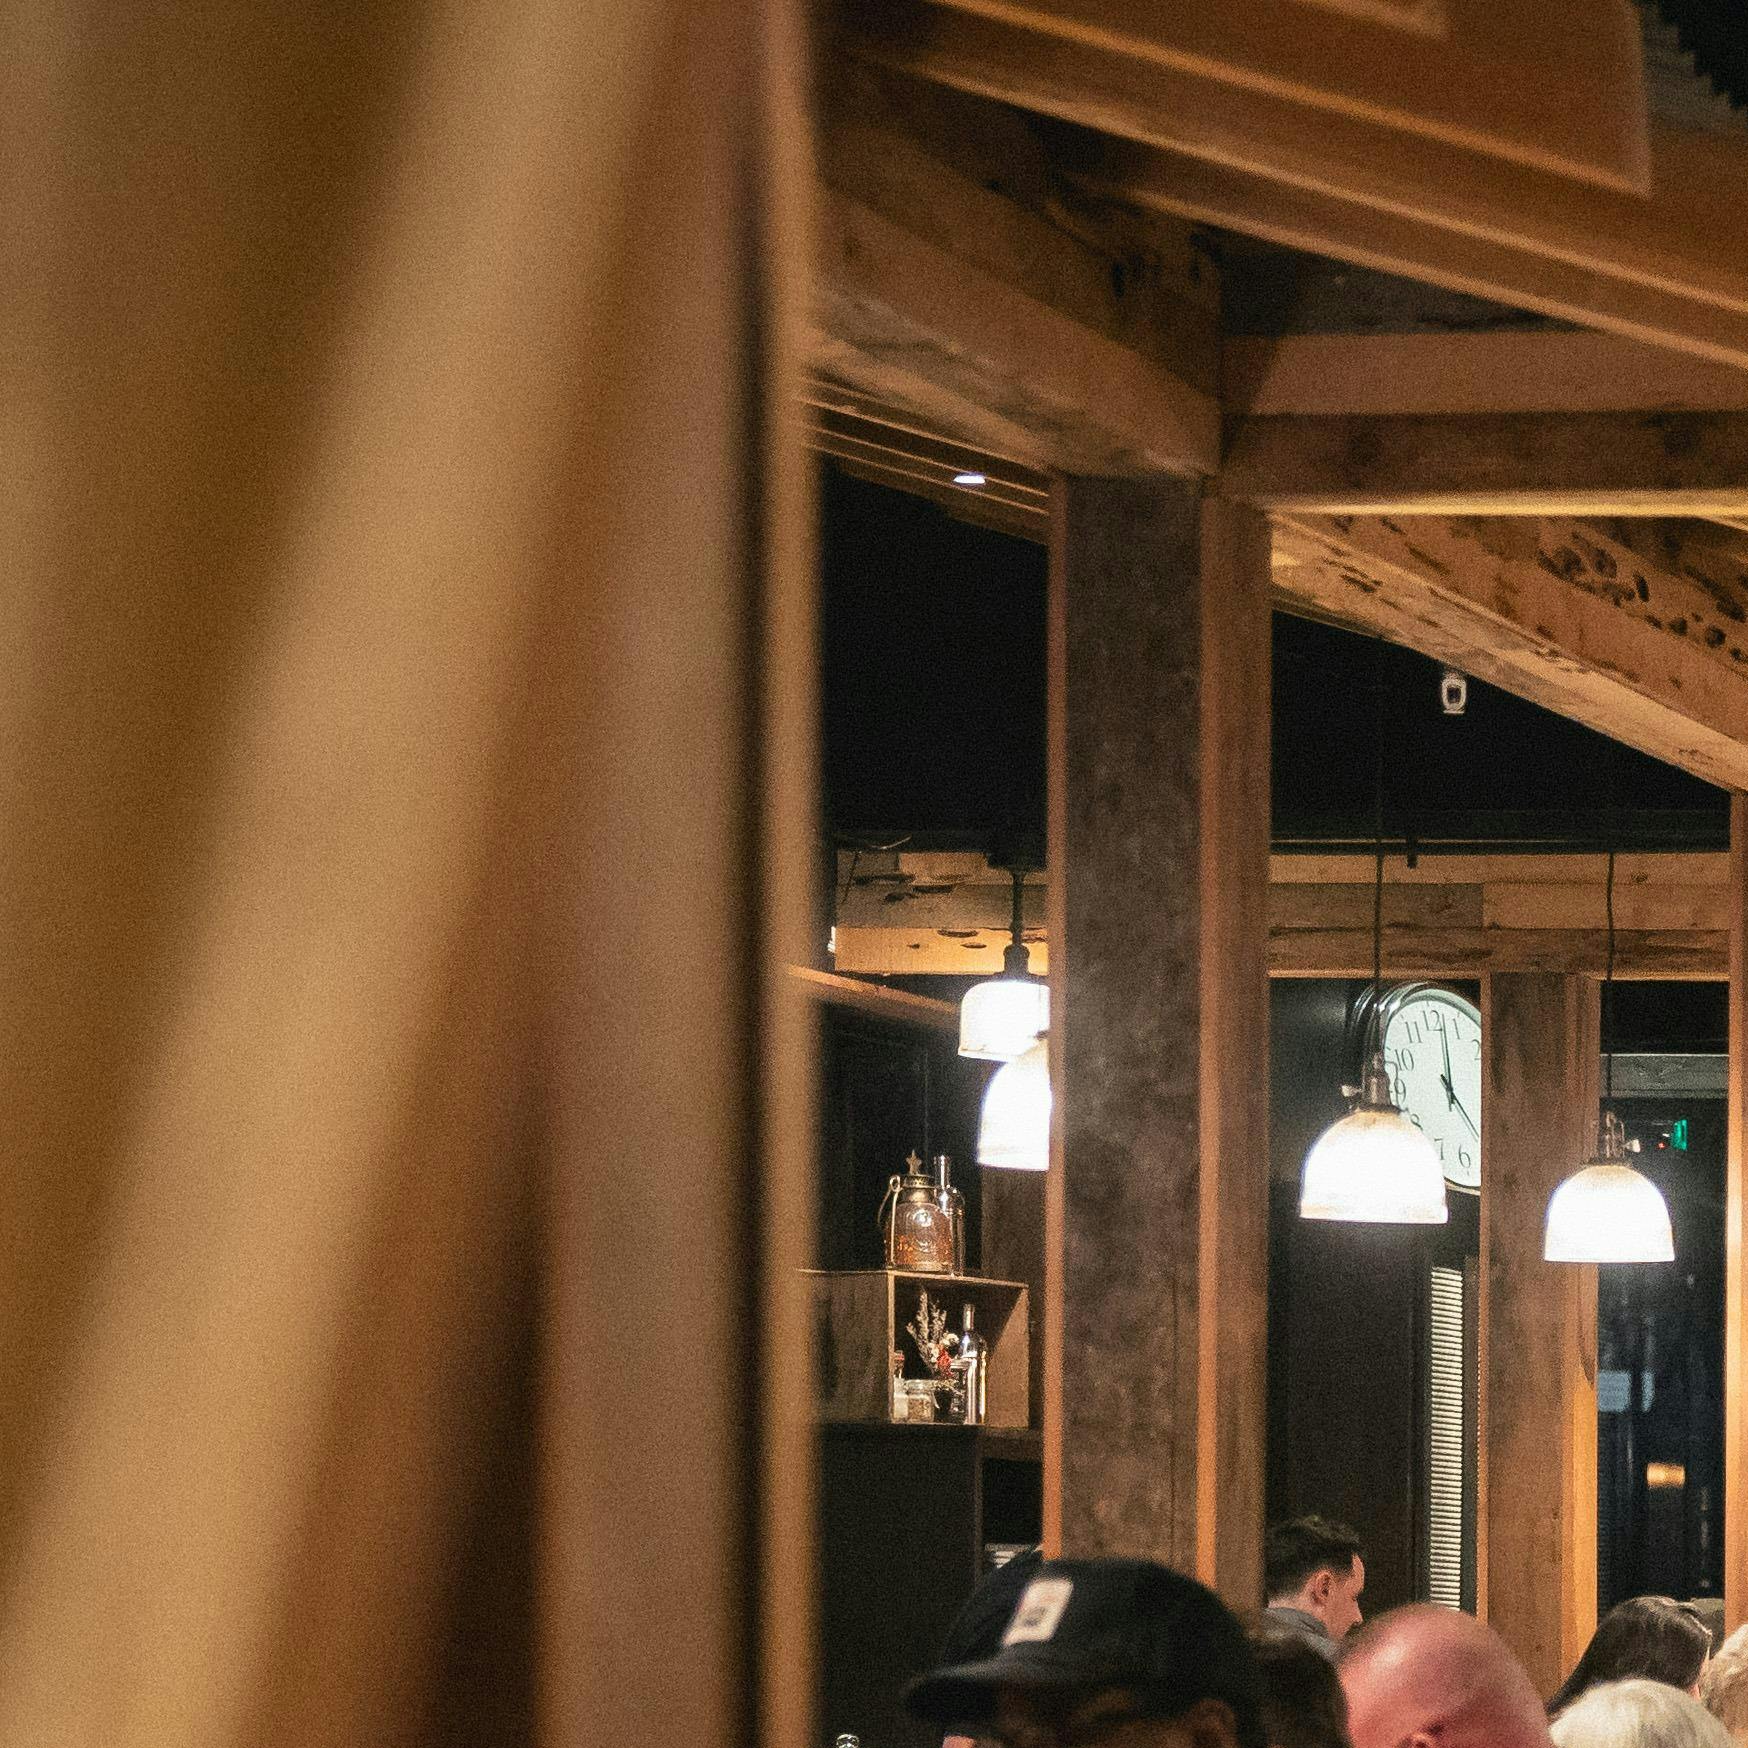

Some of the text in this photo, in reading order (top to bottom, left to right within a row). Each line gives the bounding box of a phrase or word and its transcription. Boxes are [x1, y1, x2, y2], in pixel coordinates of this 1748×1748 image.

[1423, 1010, 1442, 1031] 12
[1453, 1018, 1460, 1040] 1
[1405, 1021, 1422, 1043] 11
[1394, 1048, 1414, 1071] 10
[1472, 1039, 1480, 1060] 2
[1394, 1079, 1406, 1104] 9
[1434, 1138, 1445, 1160] 7
[1458, 1144, 1471, 1168] 6
